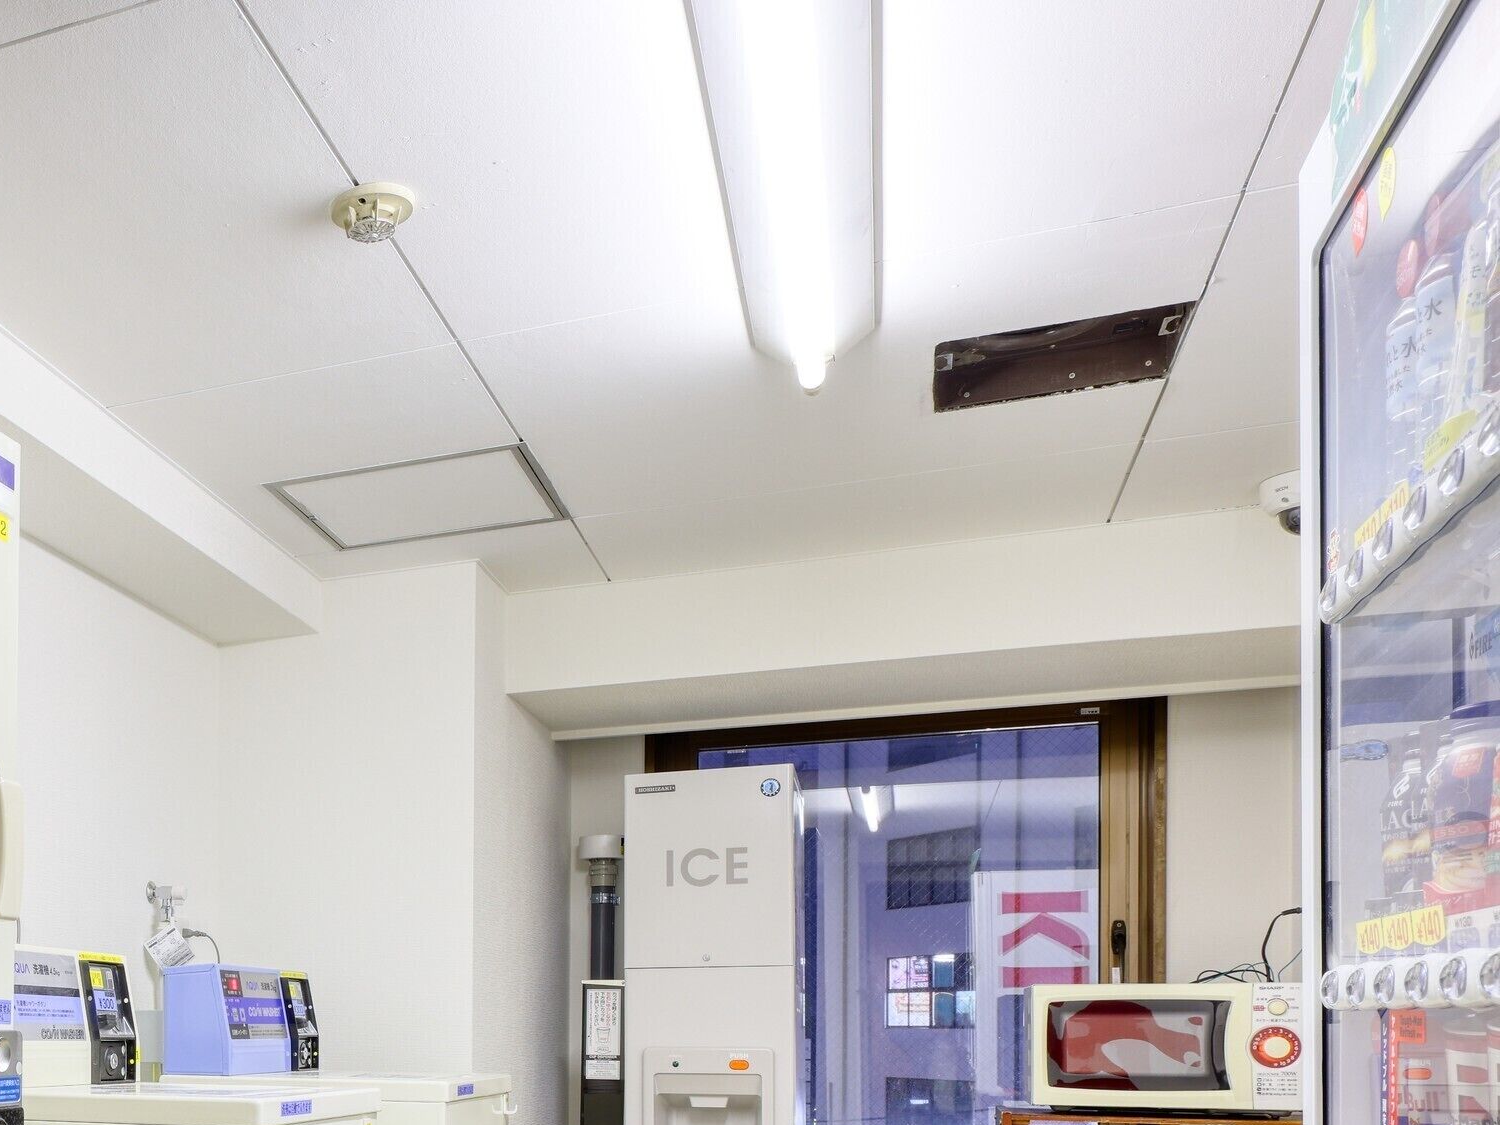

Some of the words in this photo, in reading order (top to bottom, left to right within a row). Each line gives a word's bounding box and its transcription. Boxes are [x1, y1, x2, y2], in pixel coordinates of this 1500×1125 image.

[638, 785, 673, 793] HOSHIZAKI
[666, 847, 748, 887] ICE
[1360, 923, 1380, 950] ¥140
[1388, 916, 1409, 946] ¥140
[1417, 909, 1441, 942] ¥140
[14, 963, 30, 974] QUA
